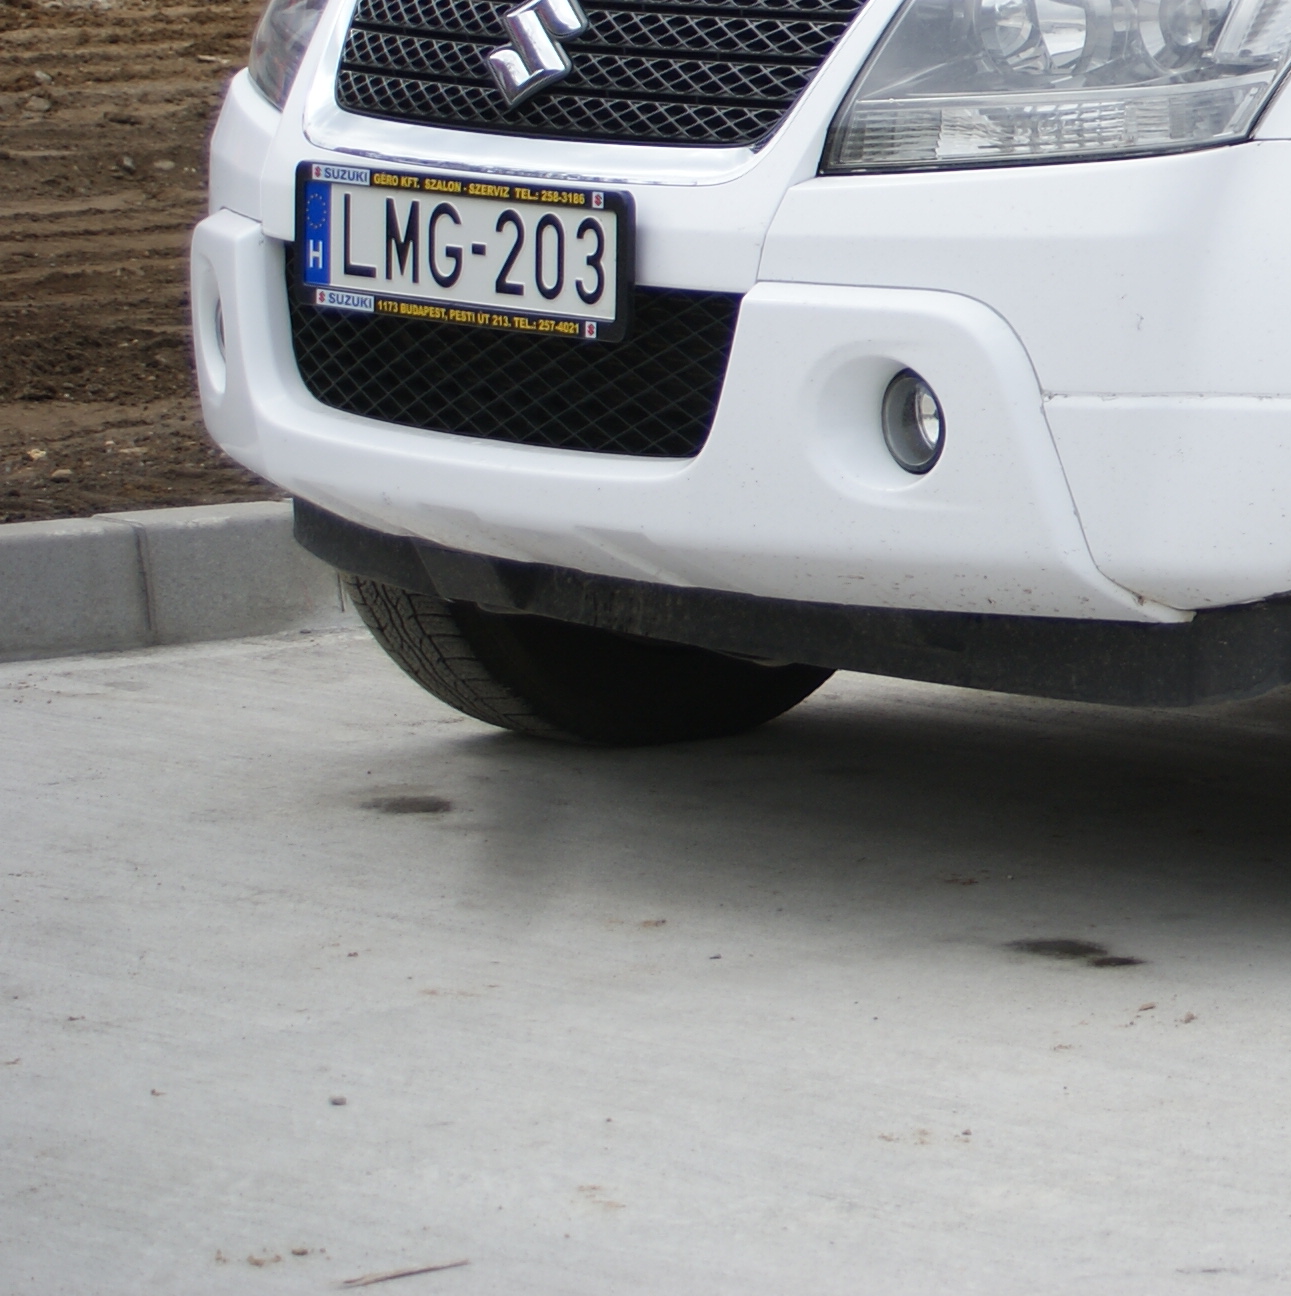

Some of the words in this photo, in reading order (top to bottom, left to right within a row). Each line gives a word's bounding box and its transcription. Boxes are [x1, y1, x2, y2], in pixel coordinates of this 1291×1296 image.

[324, 167, 368, 183] SUZUKI
[401, 176, 420, 189] KFT.
[425, 178, 461, 193] SZALON
[469, 183, 510, 198] SZERVIZ
[309, 239, 323, 270] H
[344, 192, 606, 305] LMG-203
[328, 292, 373, 310] SUZUKI
[378, 300, 398, 313] 1173
[400, 302, 448, 321] BUDAPEST,
[450, 309, 476, 323] PESTI
[492, 314, 511, 327] 213.
[538, 319, 580, 335] 257-4021
